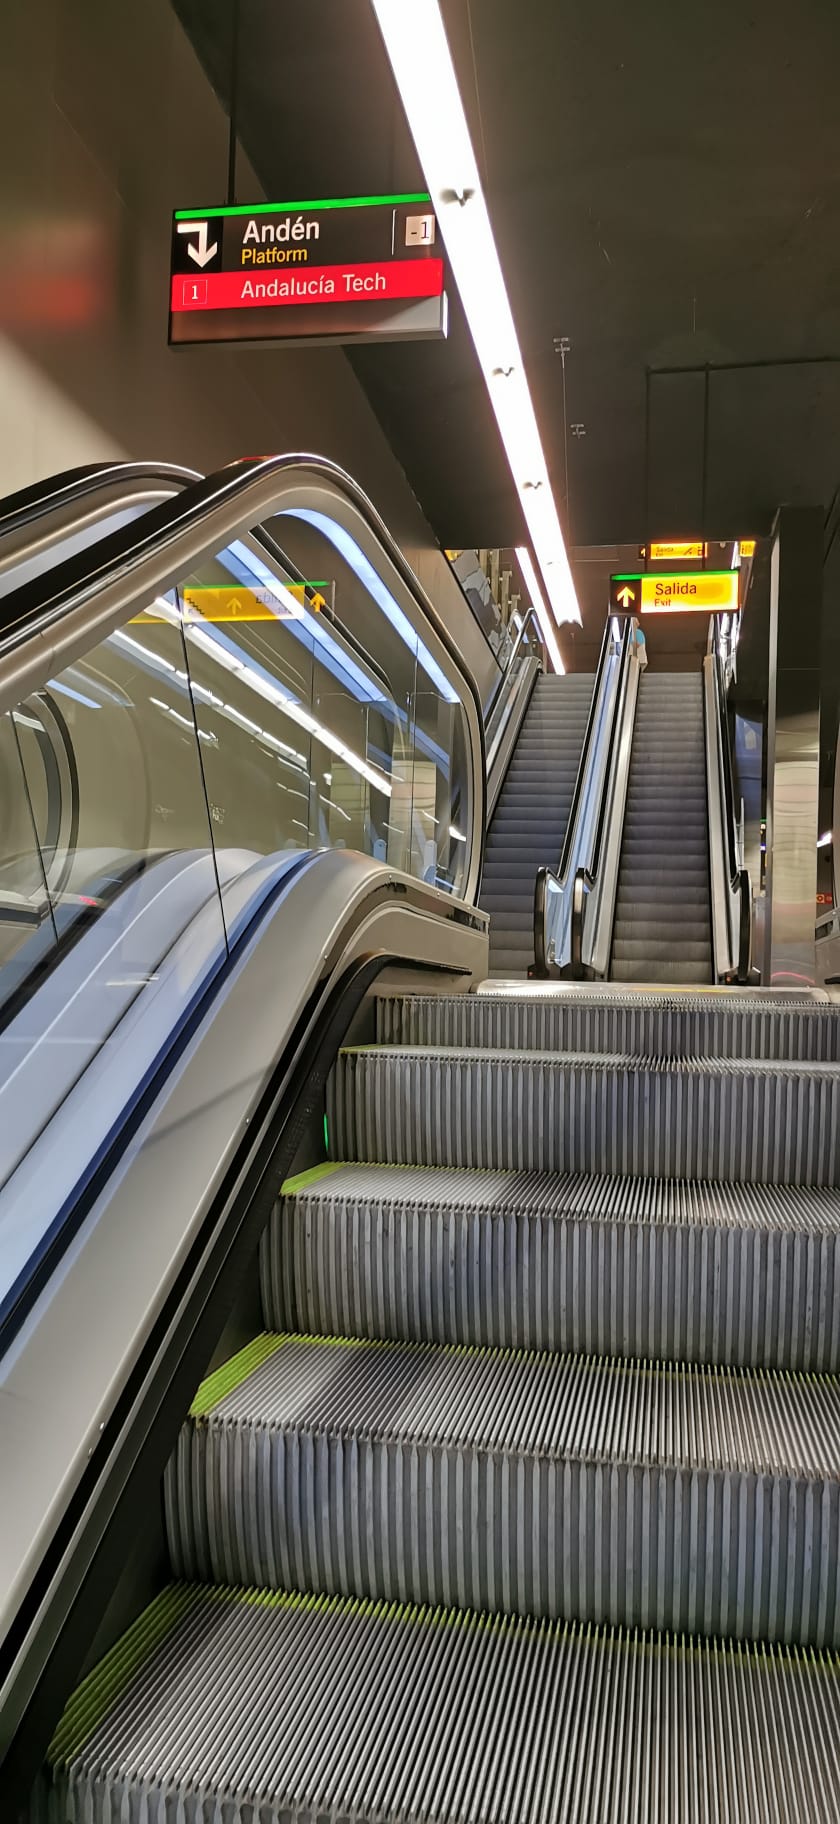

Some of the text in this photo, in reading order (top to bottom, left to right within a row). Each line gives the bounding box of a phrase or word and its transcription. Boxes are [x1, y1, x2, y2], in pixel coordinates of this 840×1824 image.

[242, 216, 320, 244] Andén
[410, 221, 430, 239] -1
[241, 246, 308, 265] Platform
[190, 285, 199, 300] 1
[240, 272, 387, 299] Andalucía Tech
[655, 582, 697, 596] Salida
[653, 597, 671, 607] Exit
